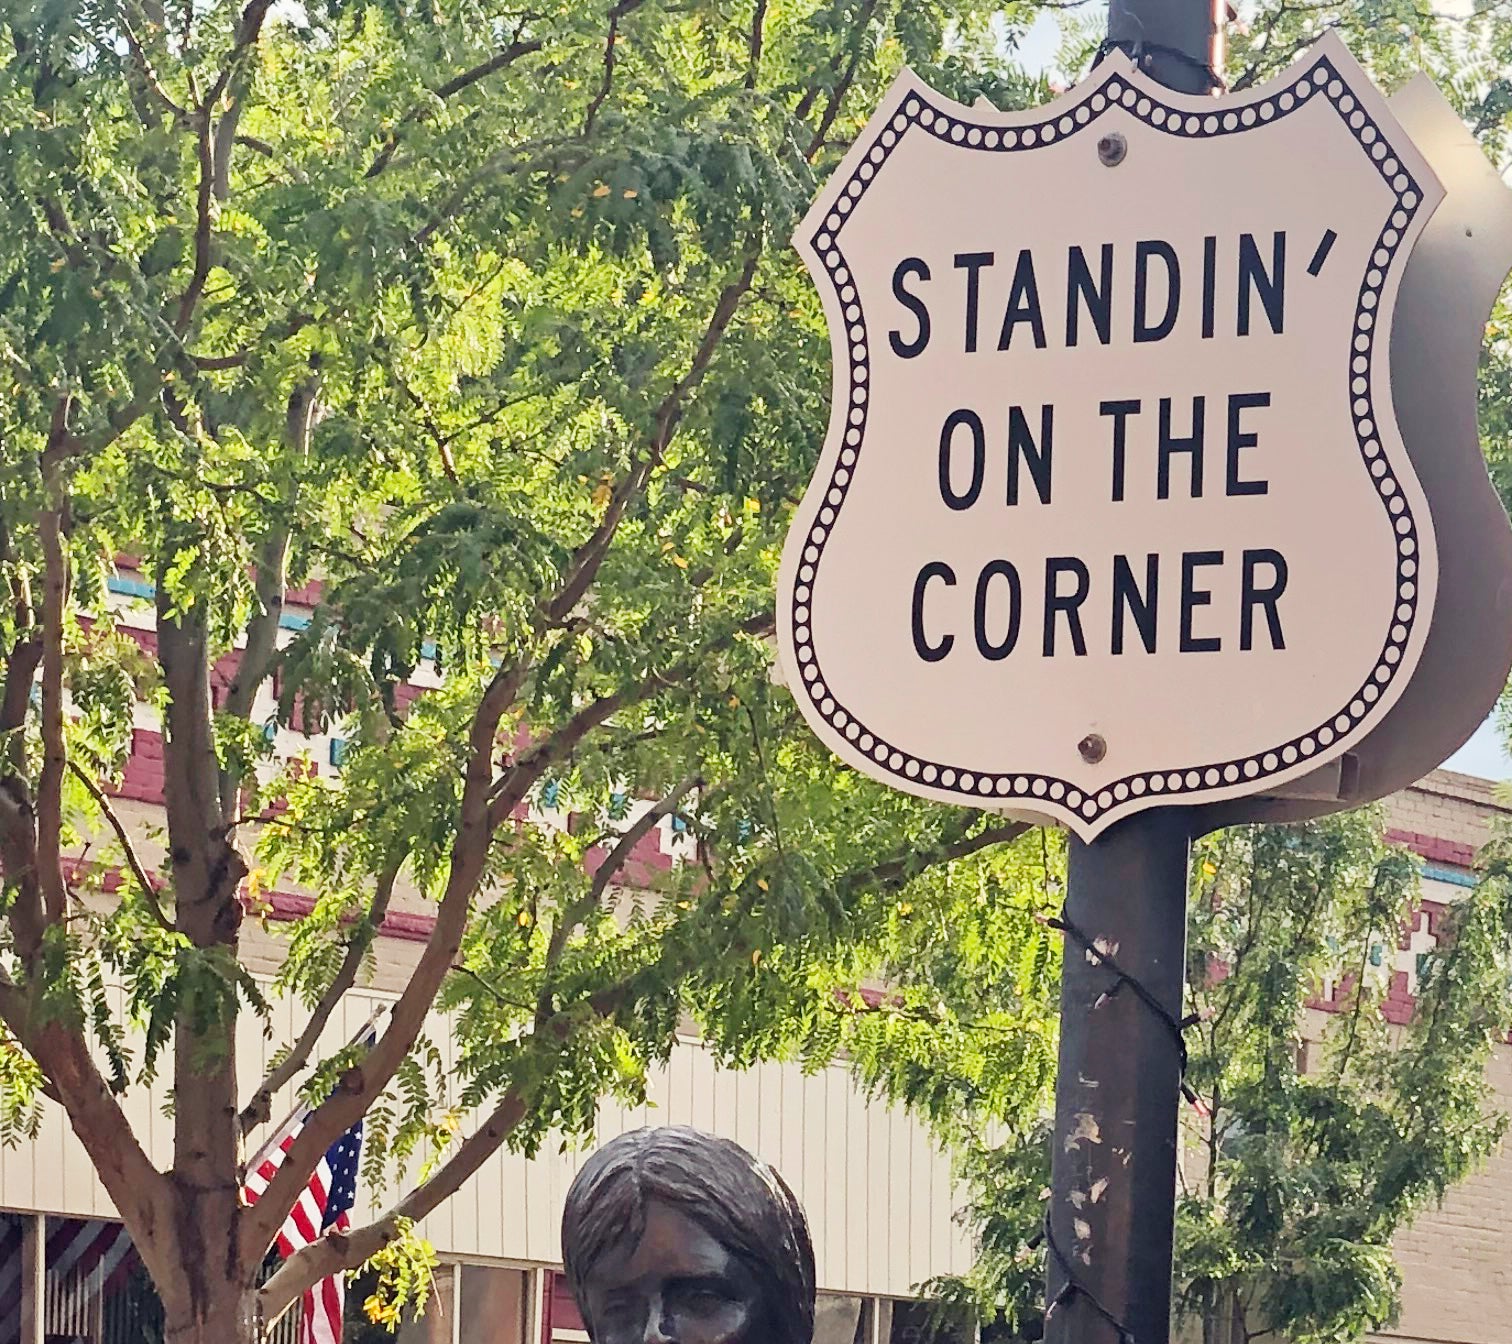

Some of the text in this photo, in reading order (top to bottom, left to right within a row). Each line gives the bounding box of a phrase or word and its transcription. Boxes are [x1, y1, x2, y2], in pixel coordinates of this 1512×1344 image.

[888, 228, 1339, 360] STANDIN'
[937, 392, 1272, 511] ON THE
[911, 548, 1290, 663] CORNER
